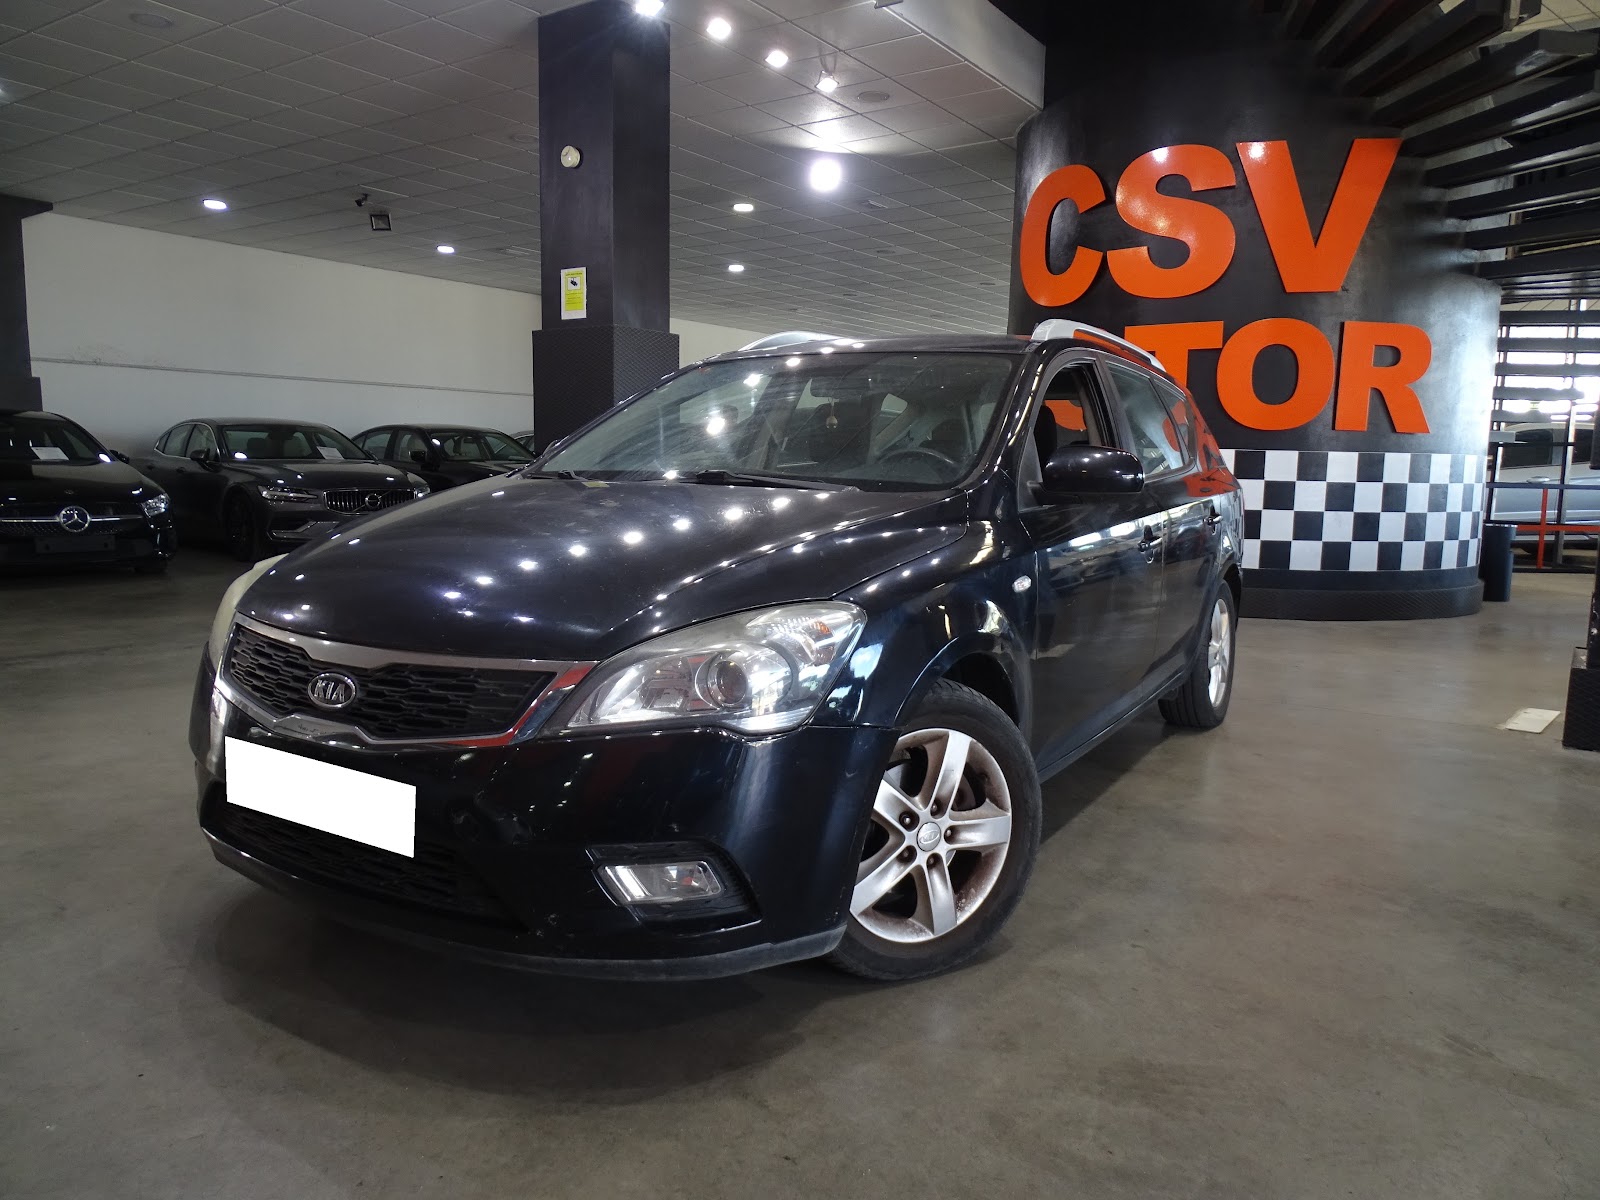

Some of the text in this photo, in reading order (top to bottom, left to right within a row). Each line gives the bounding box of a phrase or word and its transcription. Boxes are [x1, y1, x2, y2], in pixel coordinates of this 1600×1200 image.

[1020, 138, 1403, 307] CSV
[1074, 317, 1432, 434] TOR
[313, 680, 346, 703] KIA
